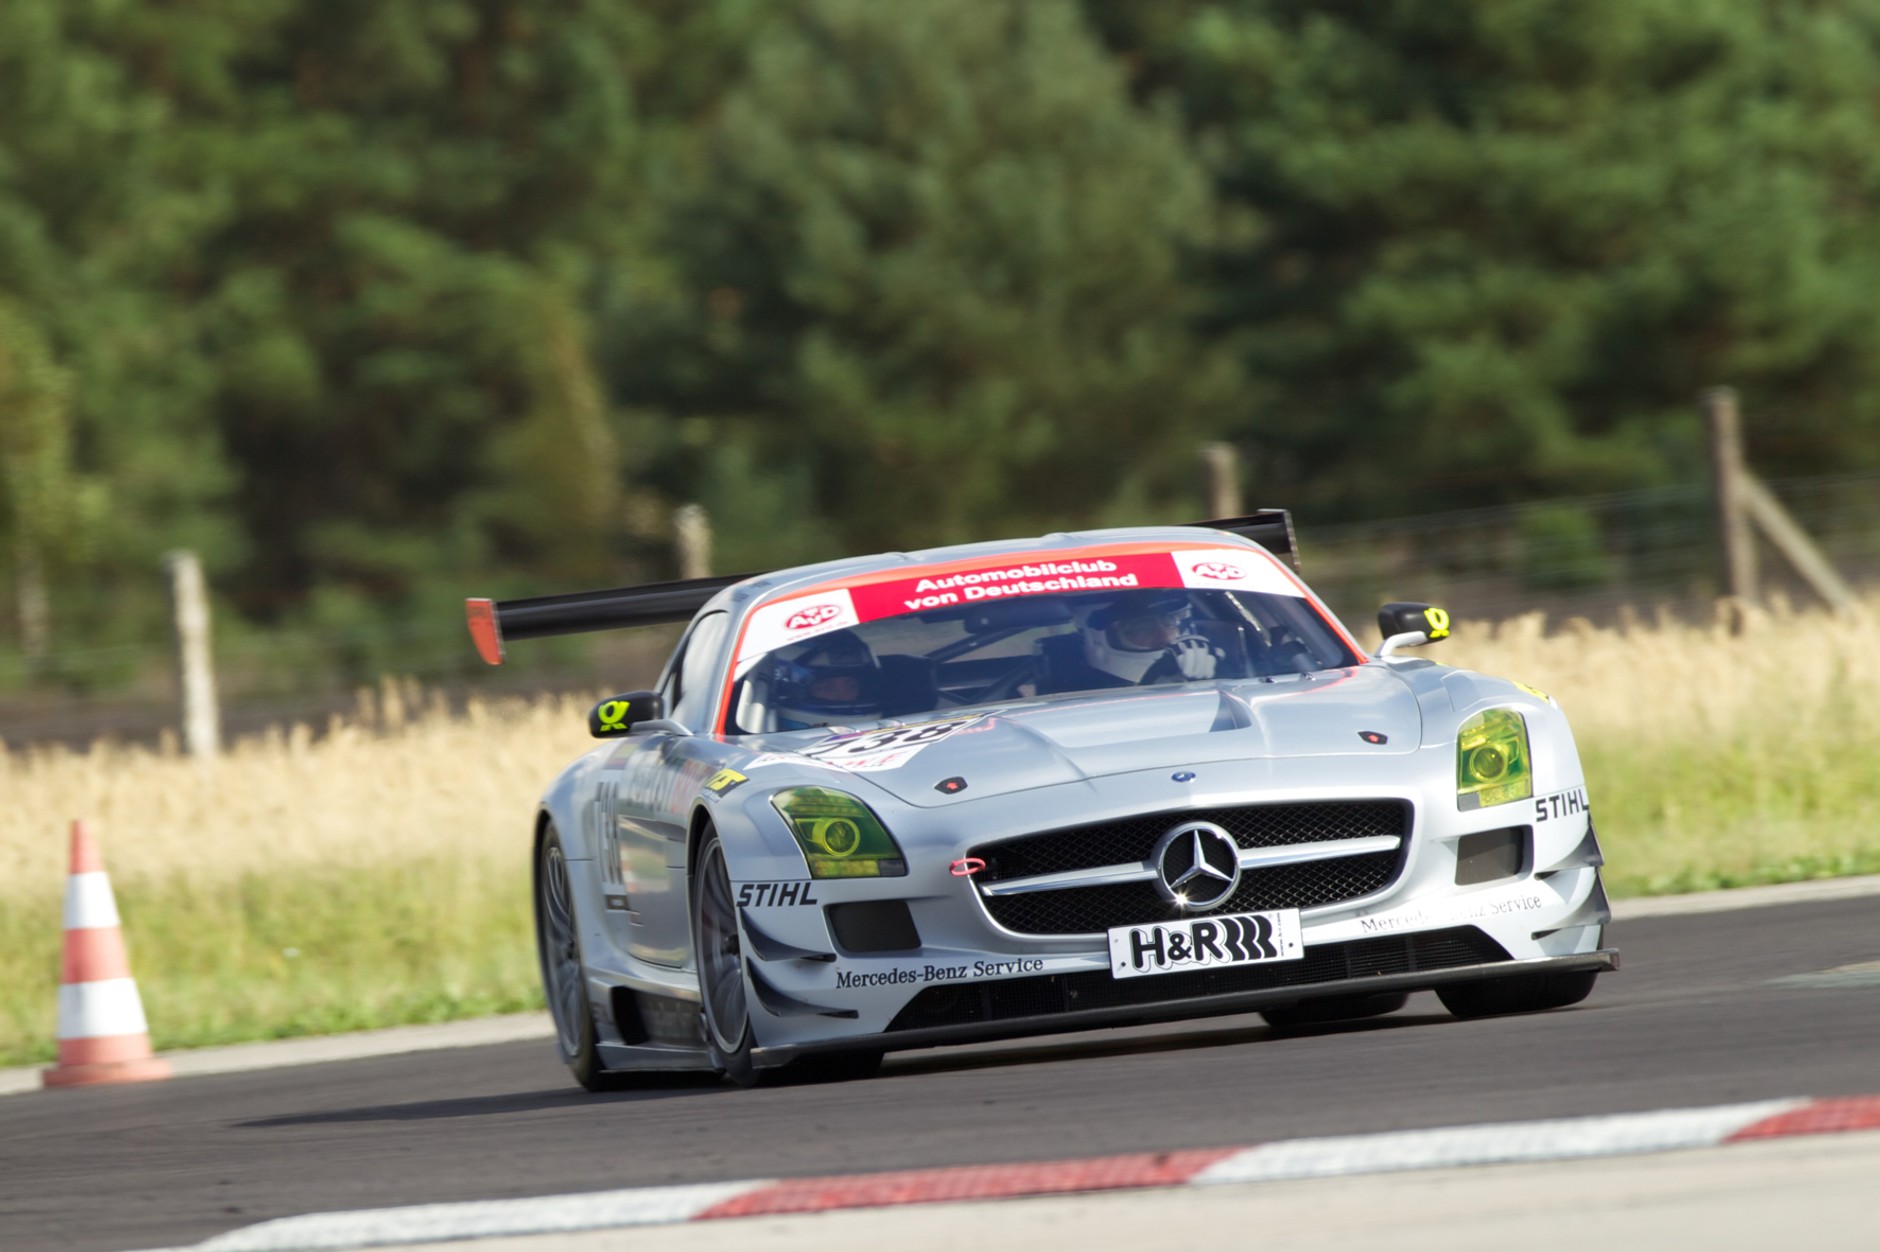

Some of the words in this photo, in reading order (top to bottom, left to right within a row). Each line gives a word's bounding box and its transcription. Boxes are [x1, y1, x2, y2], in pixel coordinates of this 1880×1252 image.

[903, 592, 959, 610] von
[963, 573, 1139, 601] Deutschland
[914, 560, 1117, 593] Automobilclub
[1536, 789, 1590, 823] STIHL
[736, 882, 818, 907] STIHL
[1490, 894, 1542, 915] Service
[836, 964, 968, 989] Mercedes-Benz
[973, 958, 1044, 978] Service
